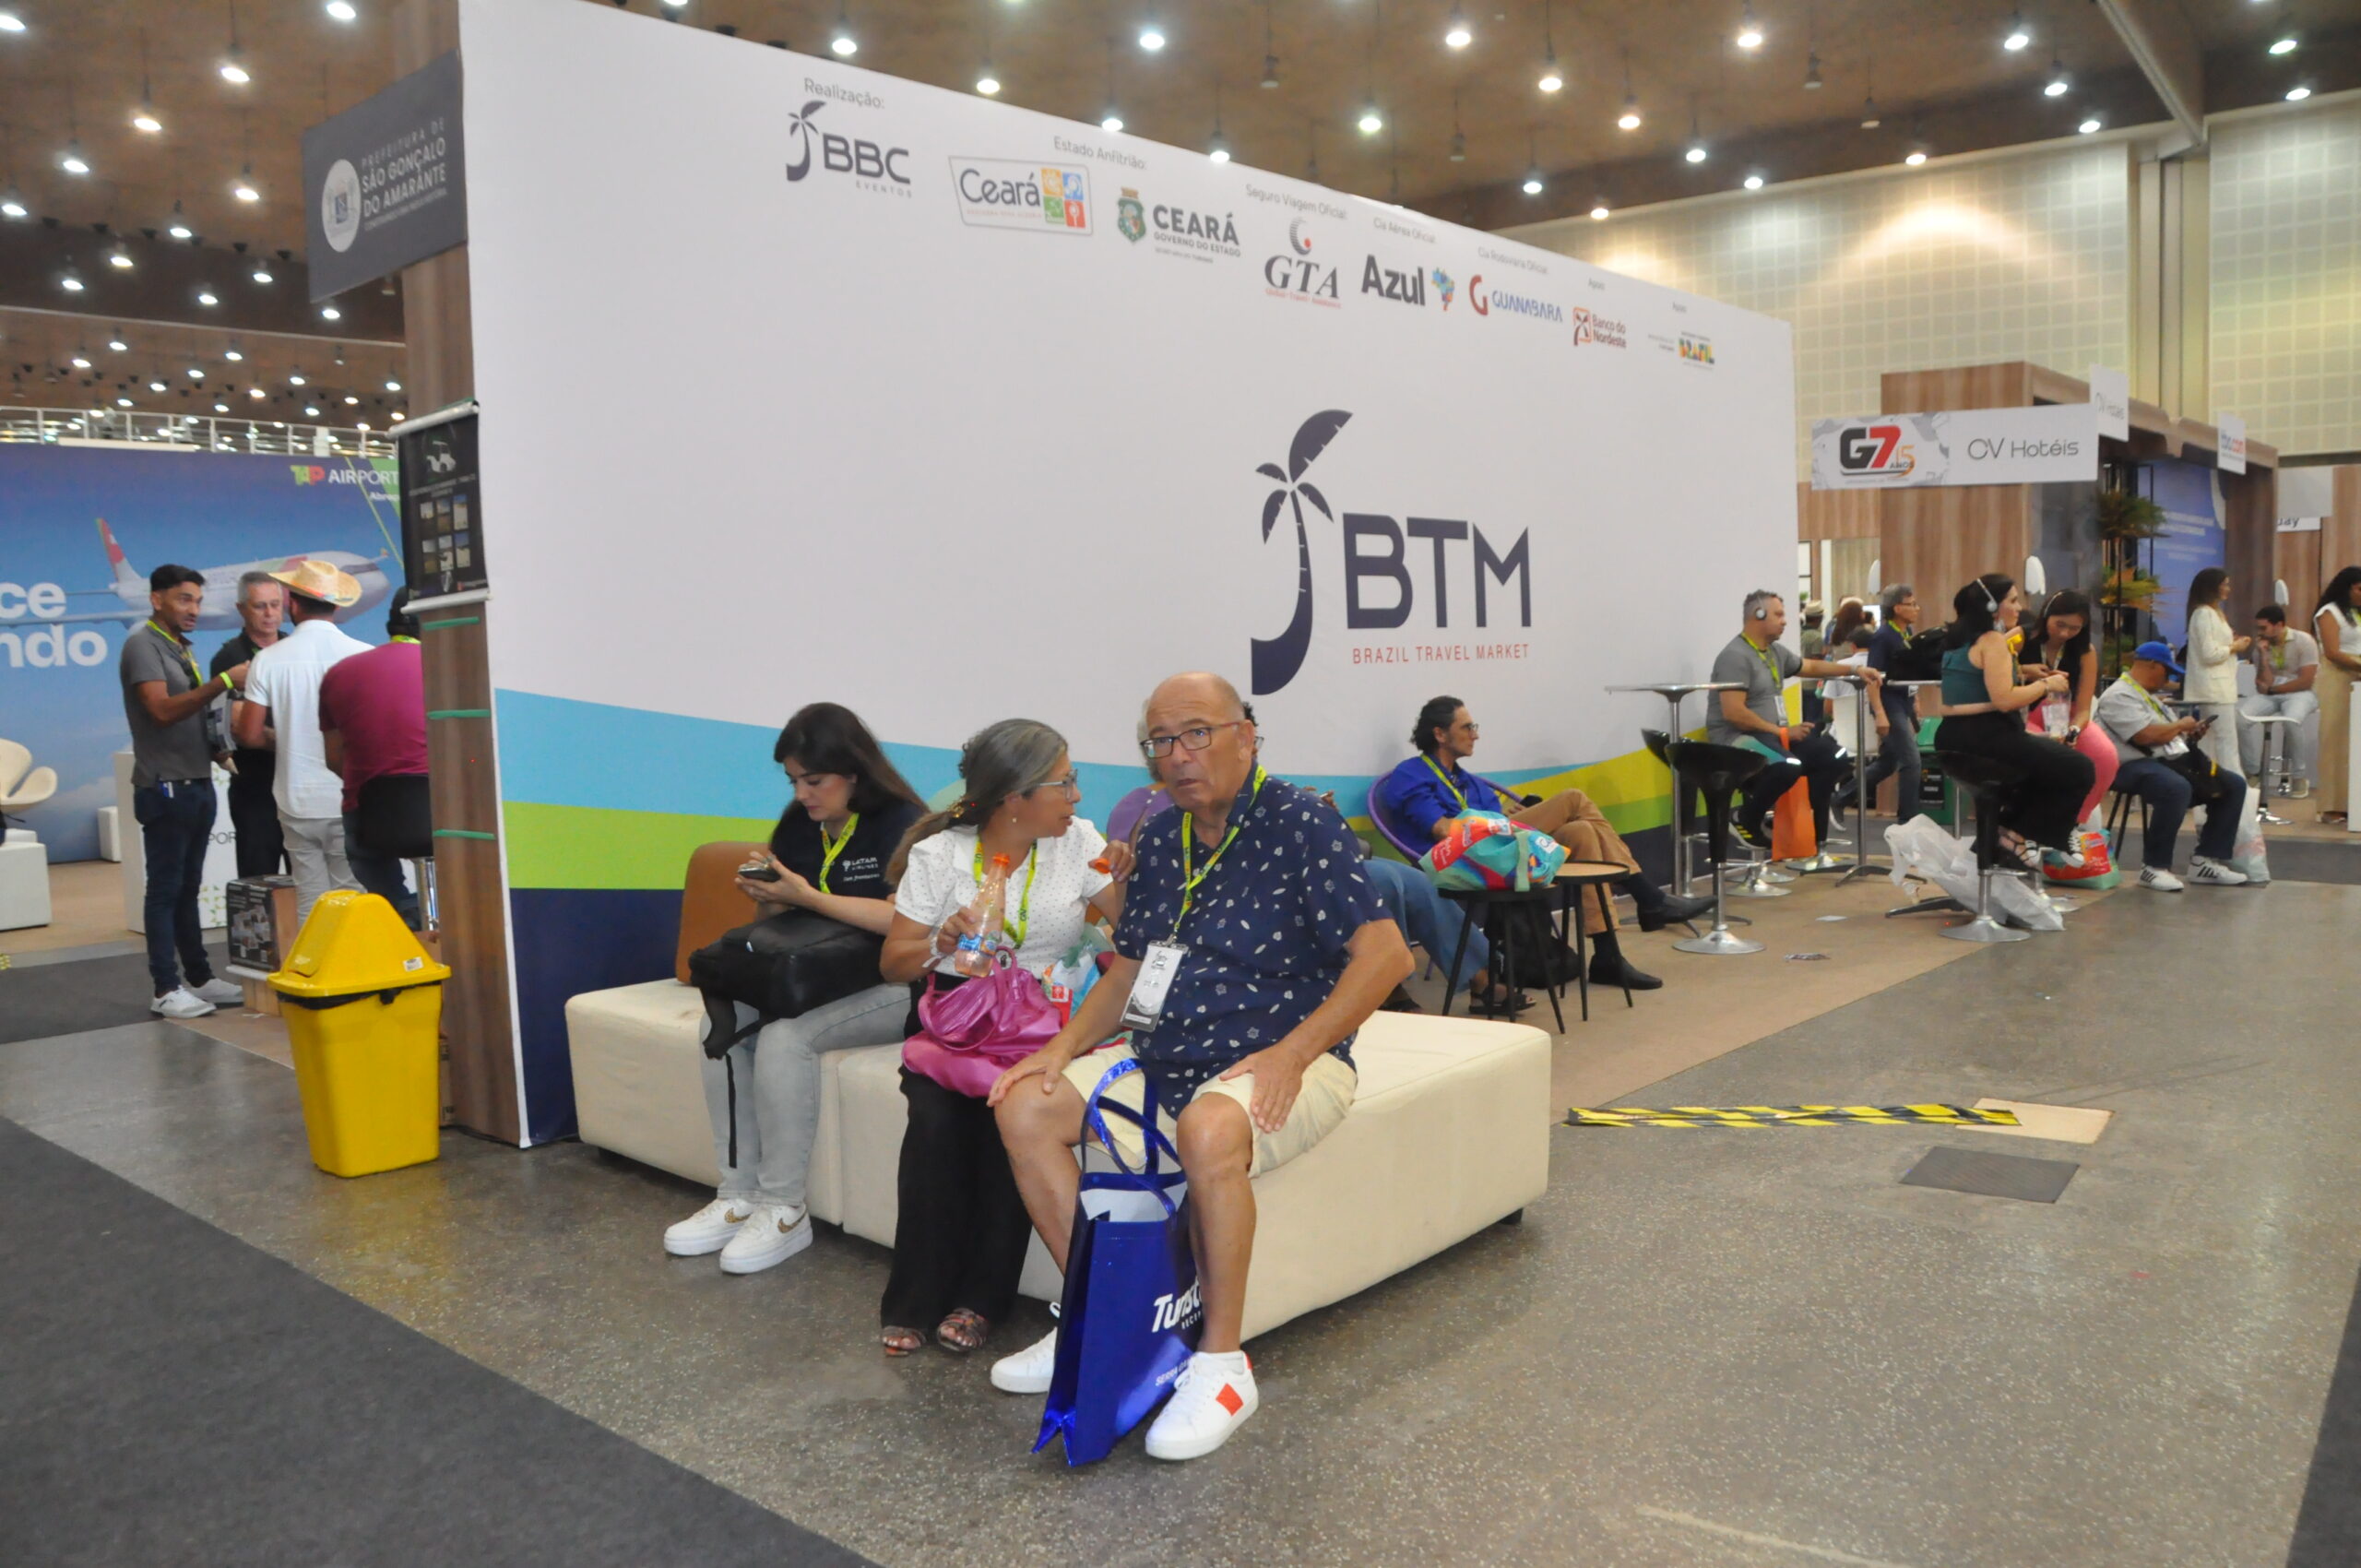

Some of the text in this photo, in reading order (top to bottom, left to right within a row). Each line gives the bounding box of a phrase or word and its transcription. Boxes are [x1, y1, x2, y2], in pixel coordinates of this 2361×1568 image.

[804, 77, 885, 110] Realização:
[822, 132, 911, 185] BBC
[1053, 136, 1094, 158] Estado
[362, 137, 446, 194] SÃO GONÇALO
[363, 195, 380, 217] DO
[384, 162, 446, 208] AMARANTE
[856, 180, 912, 198] EVENTOS
[960, 168, 1041, 207] Ceará
[1153, 203, 1240, 246] CEARÁ
[1153, 231, 1241, 258] GOVERNO DO ESTADO
[1264, 255, 1339, 299] GTA
[1361, 254, 1426, 306] Azul
[1492, 290, 1563, 323] GUANABARA
[1592, 314, 1615, 332] Banco
[1594, 329, 1627, 350] Nordeste
[1840, 425, 1902, 469] G7
[1967, 437, 2079, 460] CV Hotéis
[290, 465, 326, 486] TAP
[1343, 512, 1532, 629] BTM
[0, 582, 66, 619] ce
[1352, 644, 1529, 664] BRAZIL TRAVEL MARKET
